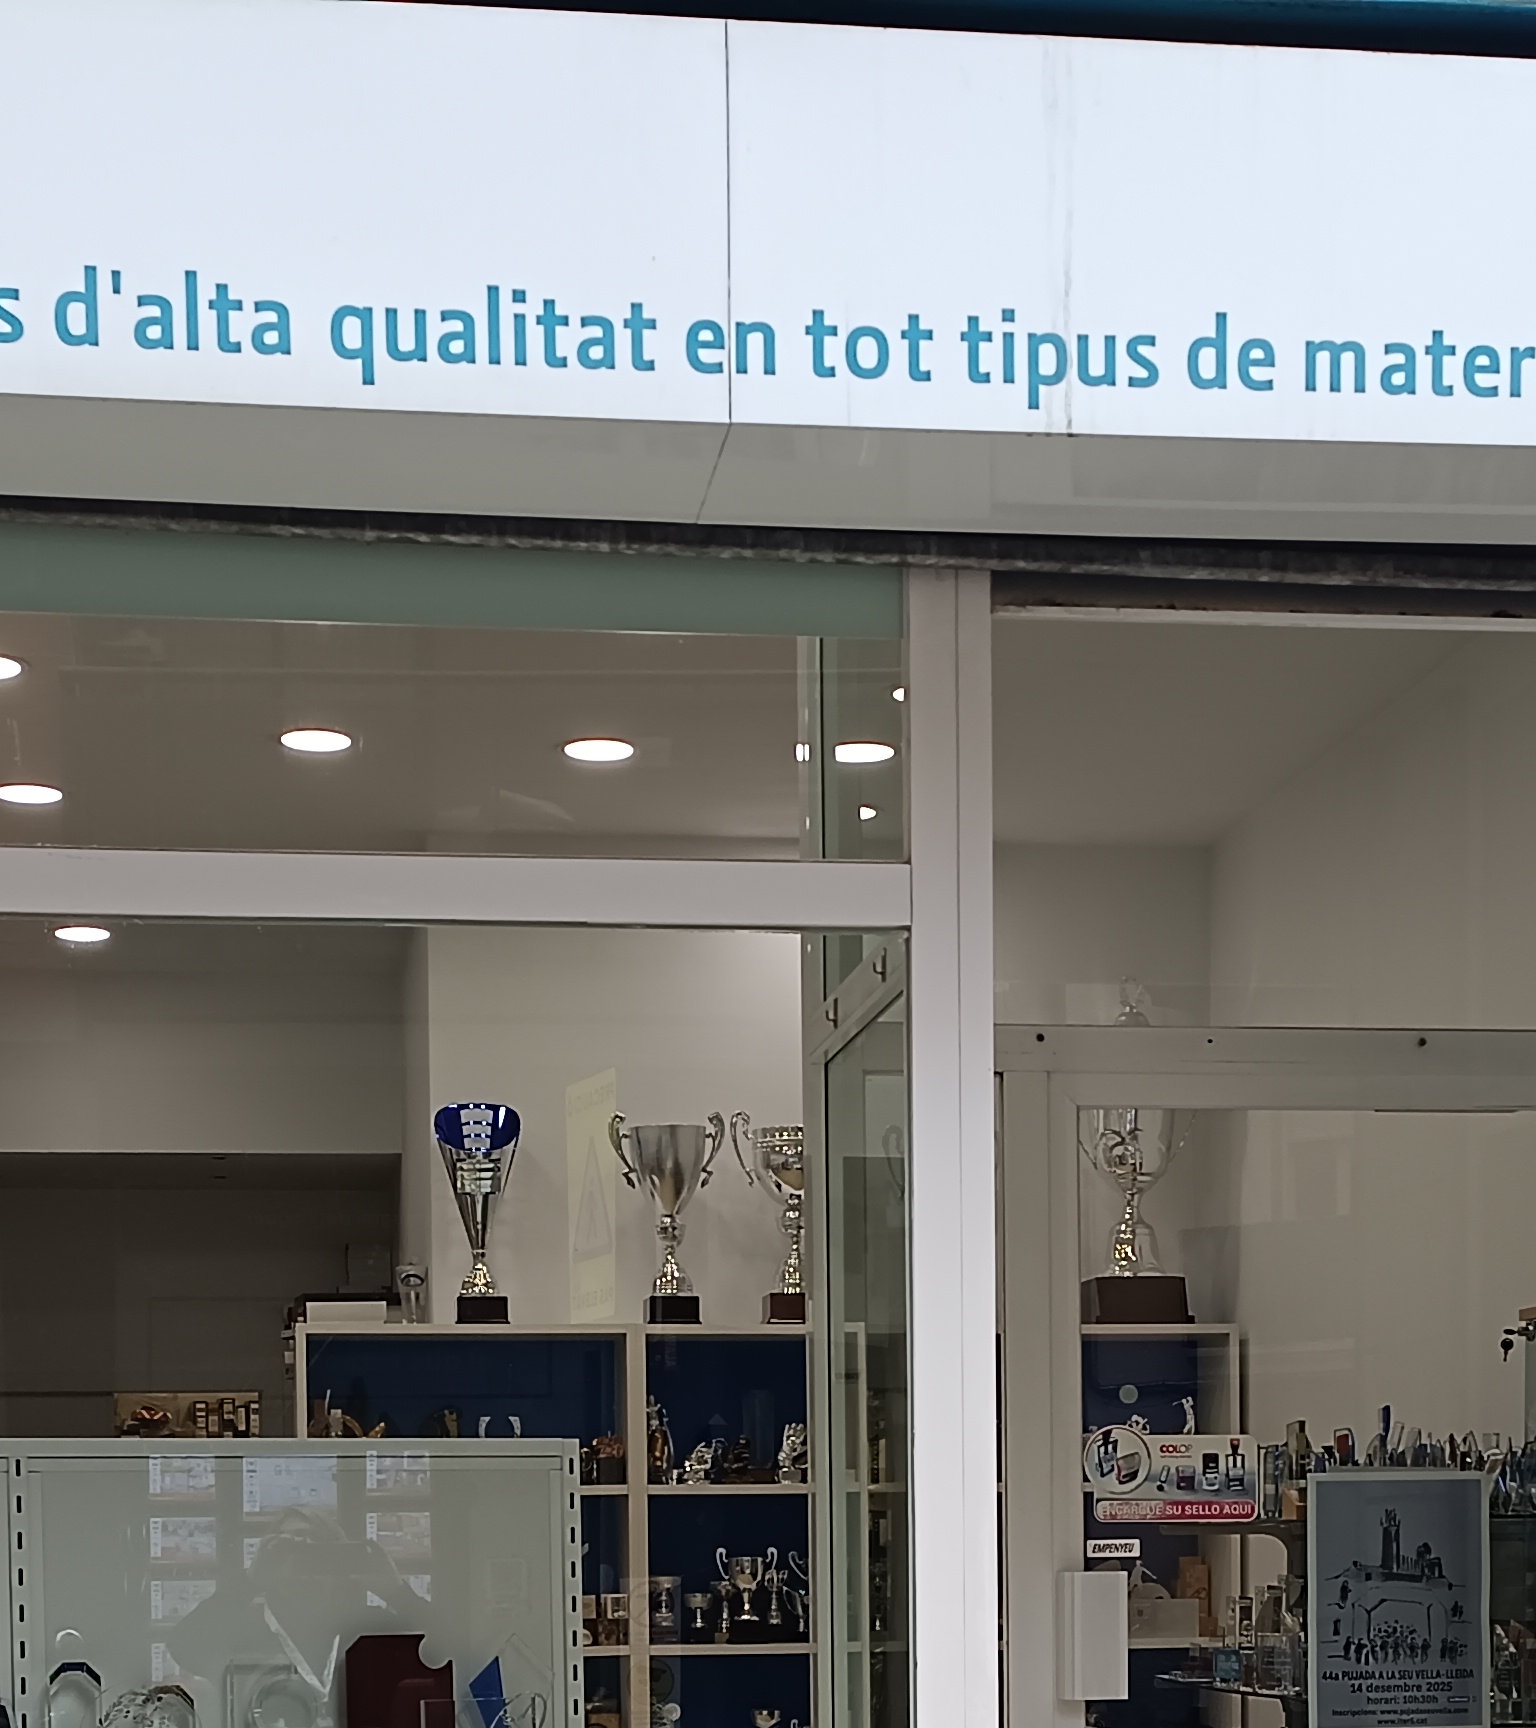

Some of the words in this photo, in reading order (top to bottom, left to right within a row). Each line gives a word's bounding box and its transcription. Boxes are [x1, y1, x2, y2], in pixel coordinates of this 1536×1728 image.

[54, 265, 292, 355] d'alta
[330, 284, 657, 386] qualitat
[685, 319, 776, 376] en
[805, 309, 934, 382] tot
[960, 308, 1160, 410] tipus
[1187, 312, 1276, 392] de
[1159, 1444, 1193, 1454] COLOP
[1165, 1505, 1182, 1515] SU
[1184, 1505, 1220, 1515] SELLO
[1223, 1504, 1252, 1515] AQUI
[1091, 1543, 1136, 1554] EMPENYEU
[1321, 1671, 1340, 1682] 44a
[1341, 1670, 1377, 1681] PUJADA
[1376, 1670, 1385, 1681] A
[1386, 1670, 1397, 1681] LA
[1397, 1669, 1414, 1680] SEU
[1350, 1682, 1364, 1694] 14
[1365, 1681, 1423, 1694] desembre
[1425, 1681, 1454, 1693] 2025
[1366, 1695, 1400, 1705] horari:
[1402, 1694, 1439, 1705] 10h30h
[1331, 1709, 1378, 1718] Inscripcions:
